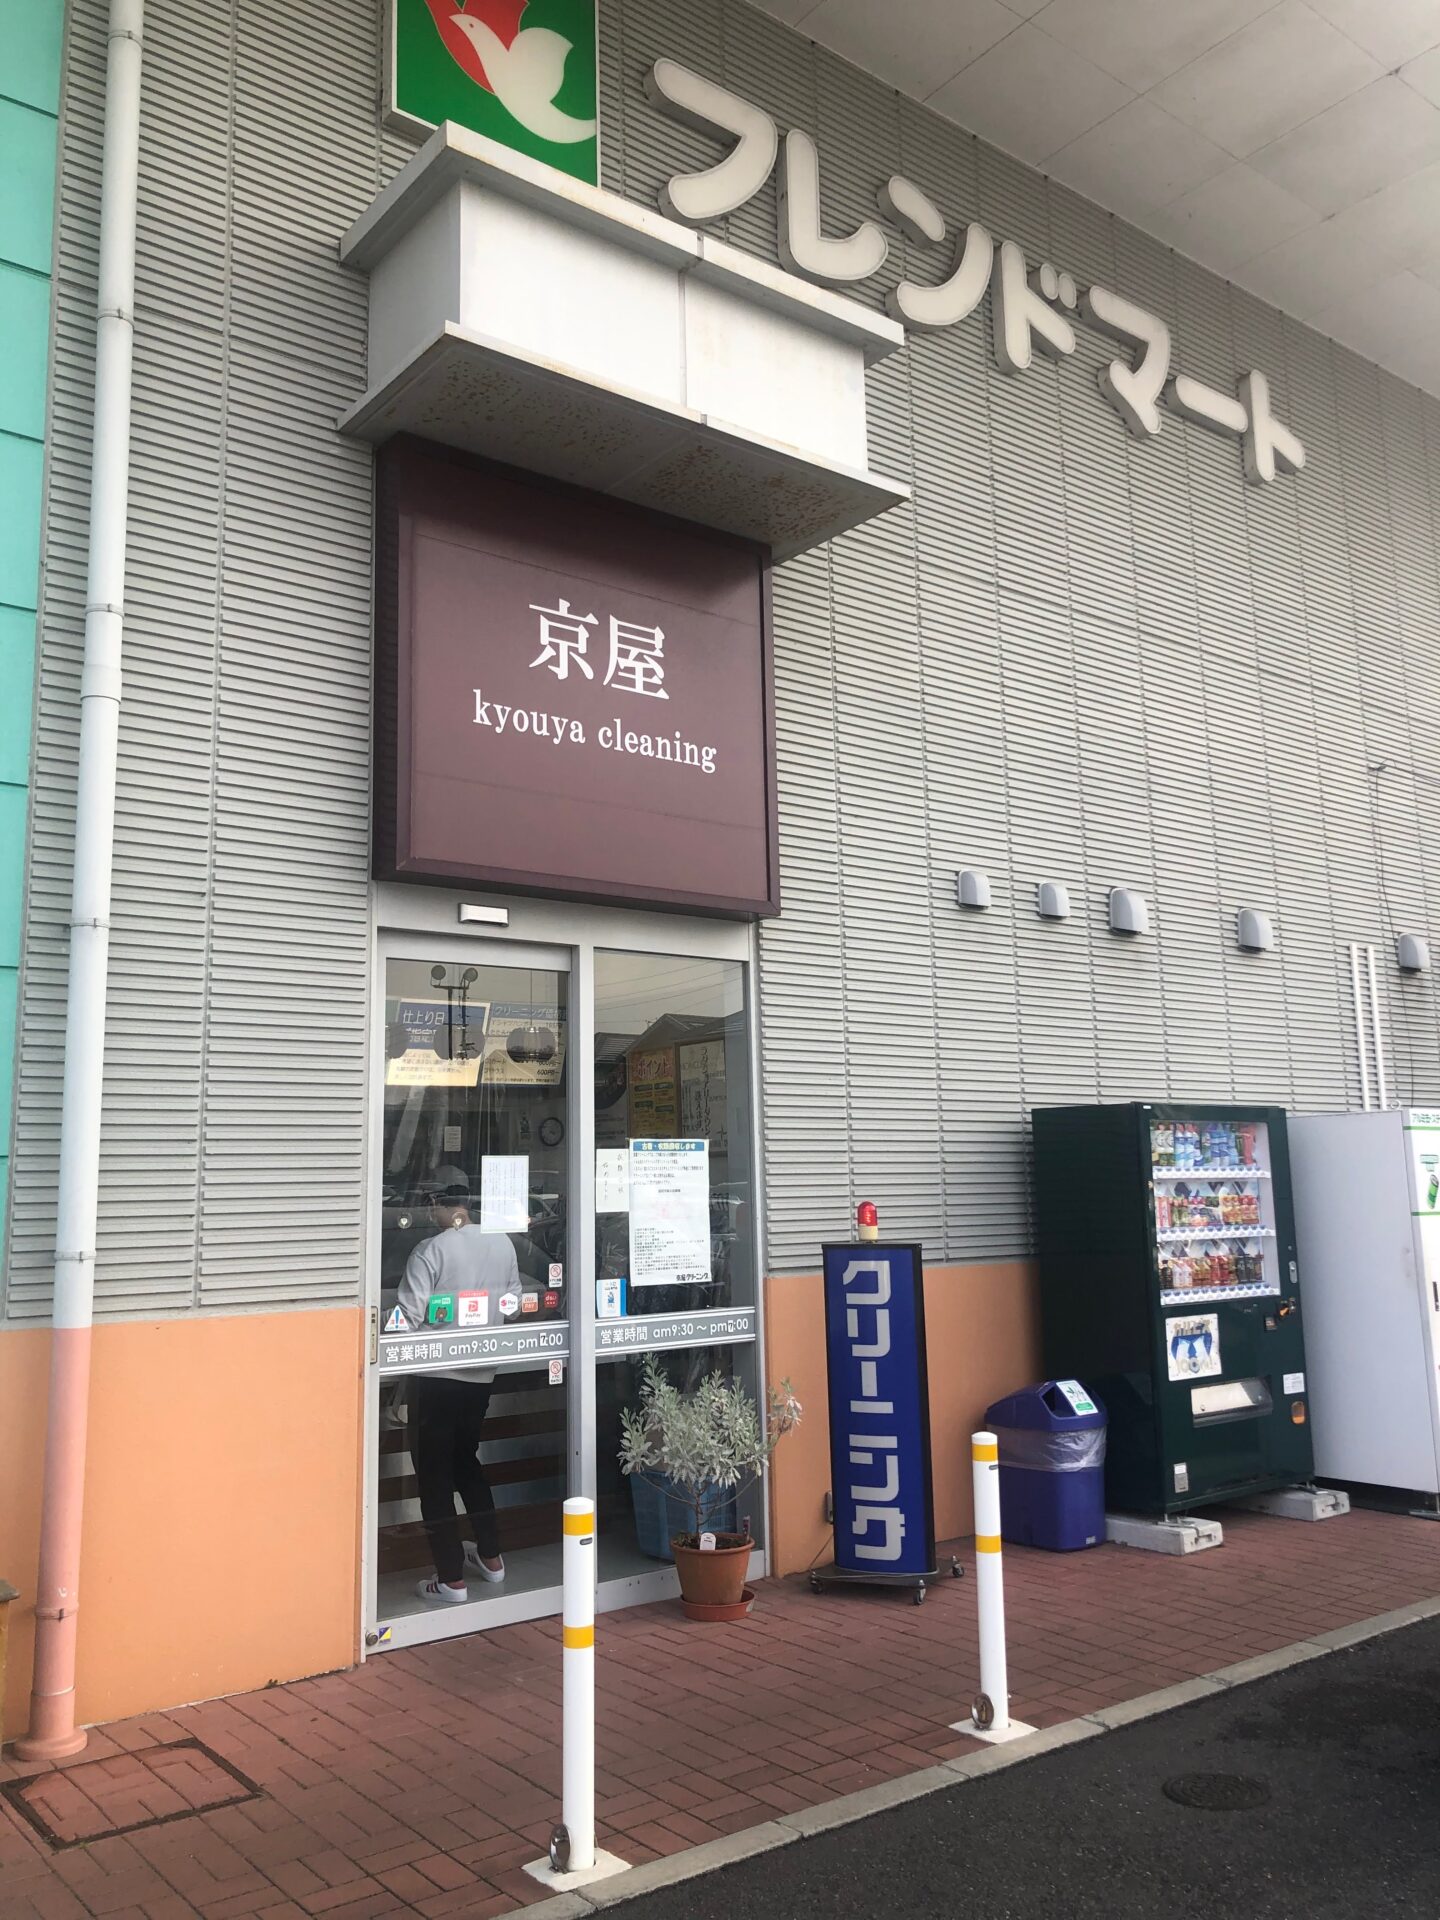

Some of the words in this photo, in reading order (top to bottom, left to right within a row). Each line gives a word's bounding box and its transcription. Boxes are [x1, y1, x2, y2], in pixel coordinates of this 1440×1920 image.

[645, 57, 1305, 484] フレンドマート
[529, 598, 669, 699] 京屋
[473, 689, 585, 744] kyouya
[598, 718, 717, 773] cleaning
[402, 1010, 445, 1025] 仕上り日
[386, 1343, 442, 1363] 営業時間
[449, 1339, 497, 1355] am9:30
[517, 1333, 563, 1351] pm7:00
[600, 1326, 647, 1344] 営業時間
[653, 1322, 694, 1338] am9:30
[710, 1318, 748, 1334] pm7:00
[843, 1260, 905, 1561] クリーニング
